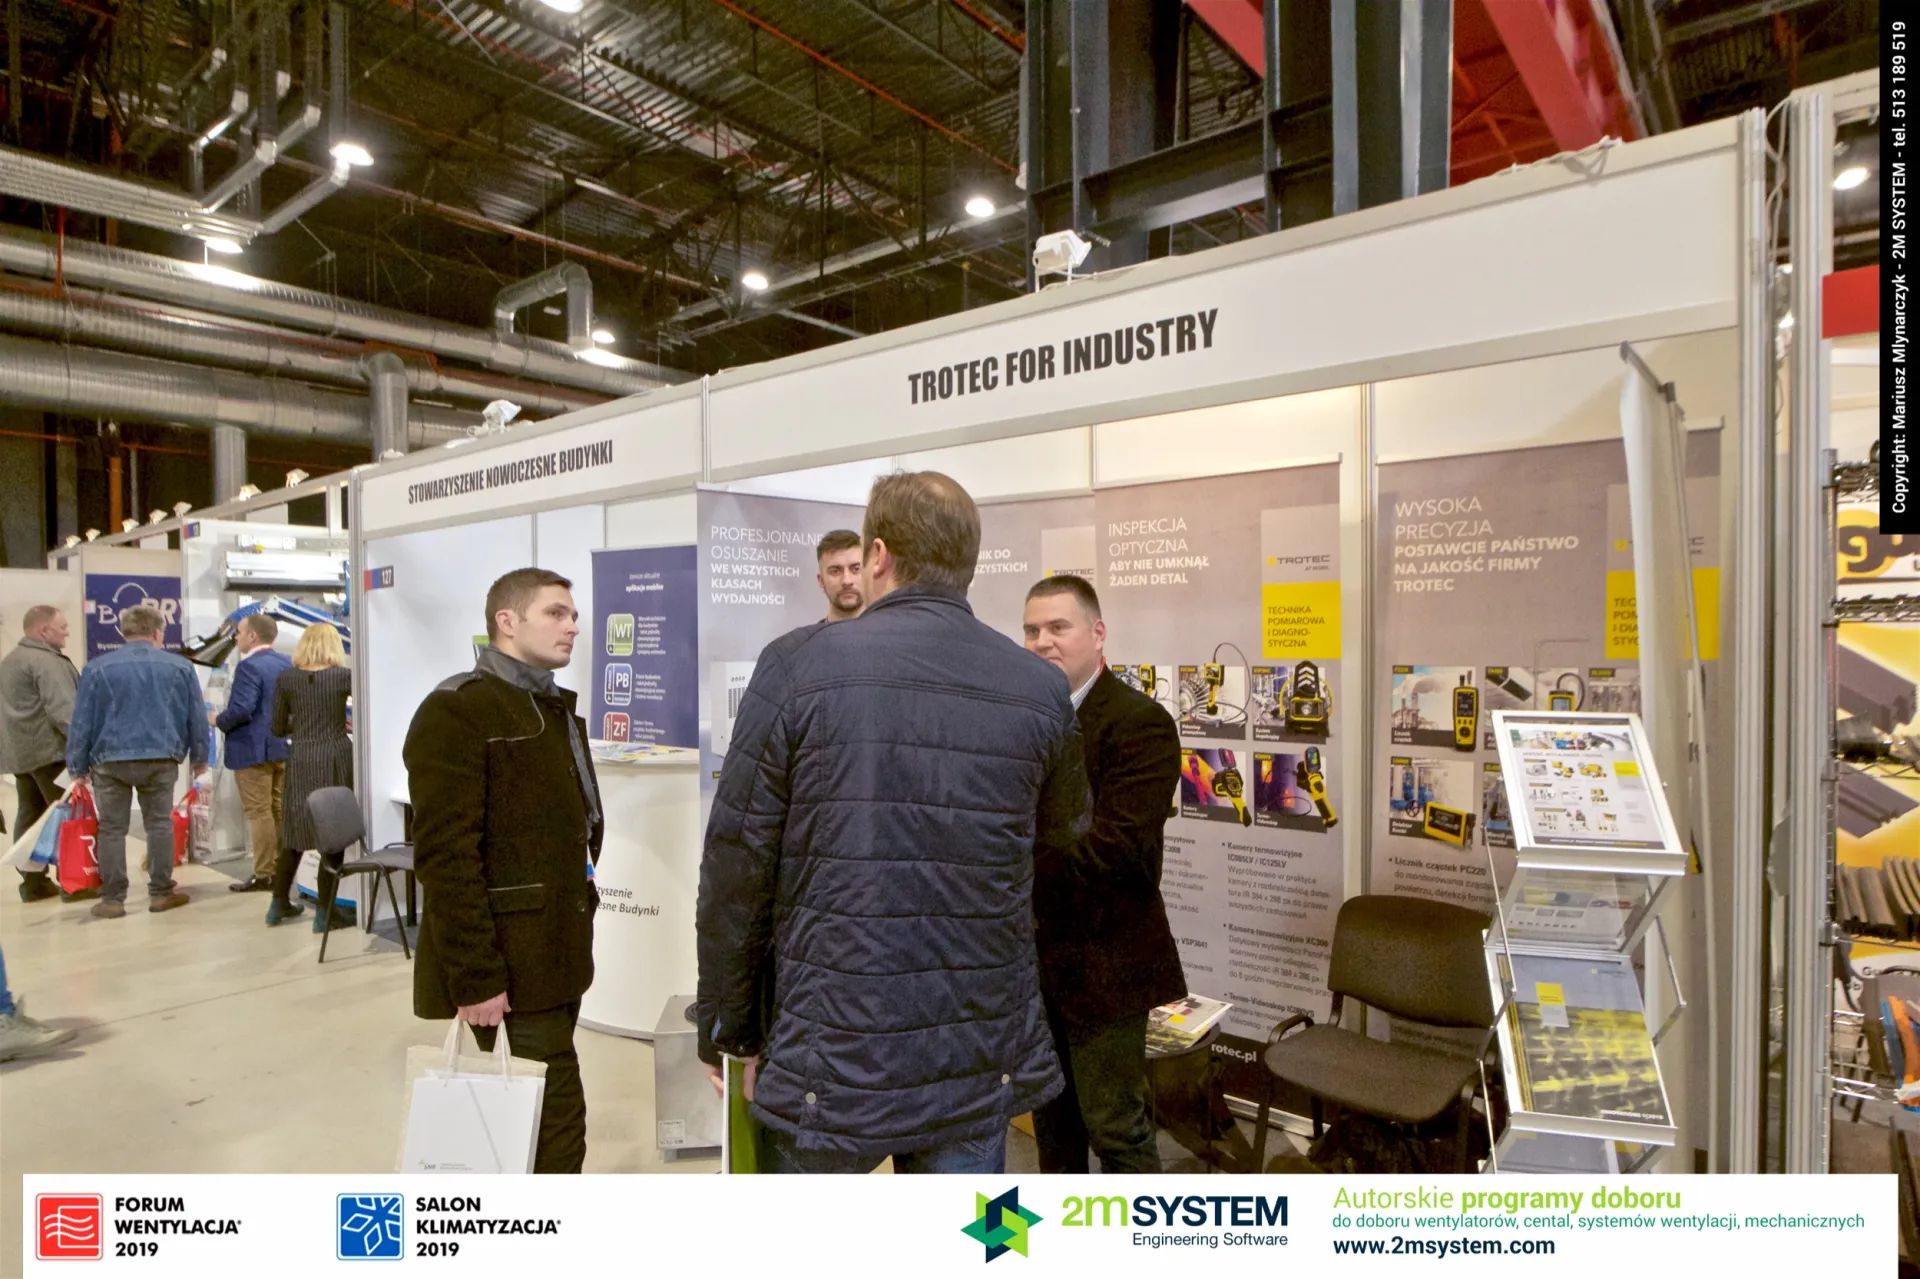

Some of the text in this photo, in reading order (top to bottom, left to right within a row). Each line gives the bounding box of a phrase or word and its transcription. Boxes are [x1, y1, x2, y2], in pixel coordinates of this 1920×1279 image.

[908, 308, 1218, 405] TROTEC FOR INDUSTRY
[408, 439, 613, 504] STOWARZYSZENIE NOWOCZESNE BUDYNKI
[1395, 496, 1482, 518] WYSOKA
[1108, 517, 1187, 537] INSPEKCJA
[1395, 519, 1494, 540] PRECYZJA
[711, 545, 788, 563] OSUSZANIE
[994, 549, 1011, 559] DO
[1109, 538, 1188, 557] OPTYCZNA
[1395, 536, 1579, 558] POSTAWCIE PAŃSTWO
[1108, 555, 1210, 572] ABY NIE UMKNĄŁ
[1277, 555, 1330, 564] TROTEC
[1394, 556, 1542, 575] NA JAKOŚĆ FIRMY
[711, 563, 800, 577] WE WSZYSTKICH
[974, 562, 1028, 574] SZYSTKICH
[382, 569, 391, 585] 127
[711, 578, 762, 590] KLASACH
[1109, 573, 1188, 587] ŻADEN DETAL
[1394, 579, 1454, 593] TROTEC
[711, 592, 785, 605] WYDAJNOŚCI
[1614, 598, 1636, 607] TEC
[1268, 606, 1312, 615] TECHNIKA
[1268, 617, 1326, 626] POMIAROWA
[615, 624, 632, 638] WT
[1272, 628, 1311, 637] DIAGNO-
[1268, 639, 1307, 648] STYCZNA
[616, 673, 629, 687] PB
[613, 722, 627, 737] ZF
[1228, 842, 1303, 858] Kamery termowizyjne
[1395, 857, 1423, 868] Licznik
[1425, 861, 1457, 873] cząstek
[597, 886, 632, 899] zyszenie
[598, 901, 659, 916] esne Budynki
[1211, 1043, 1257, 1062] rotec.pl
